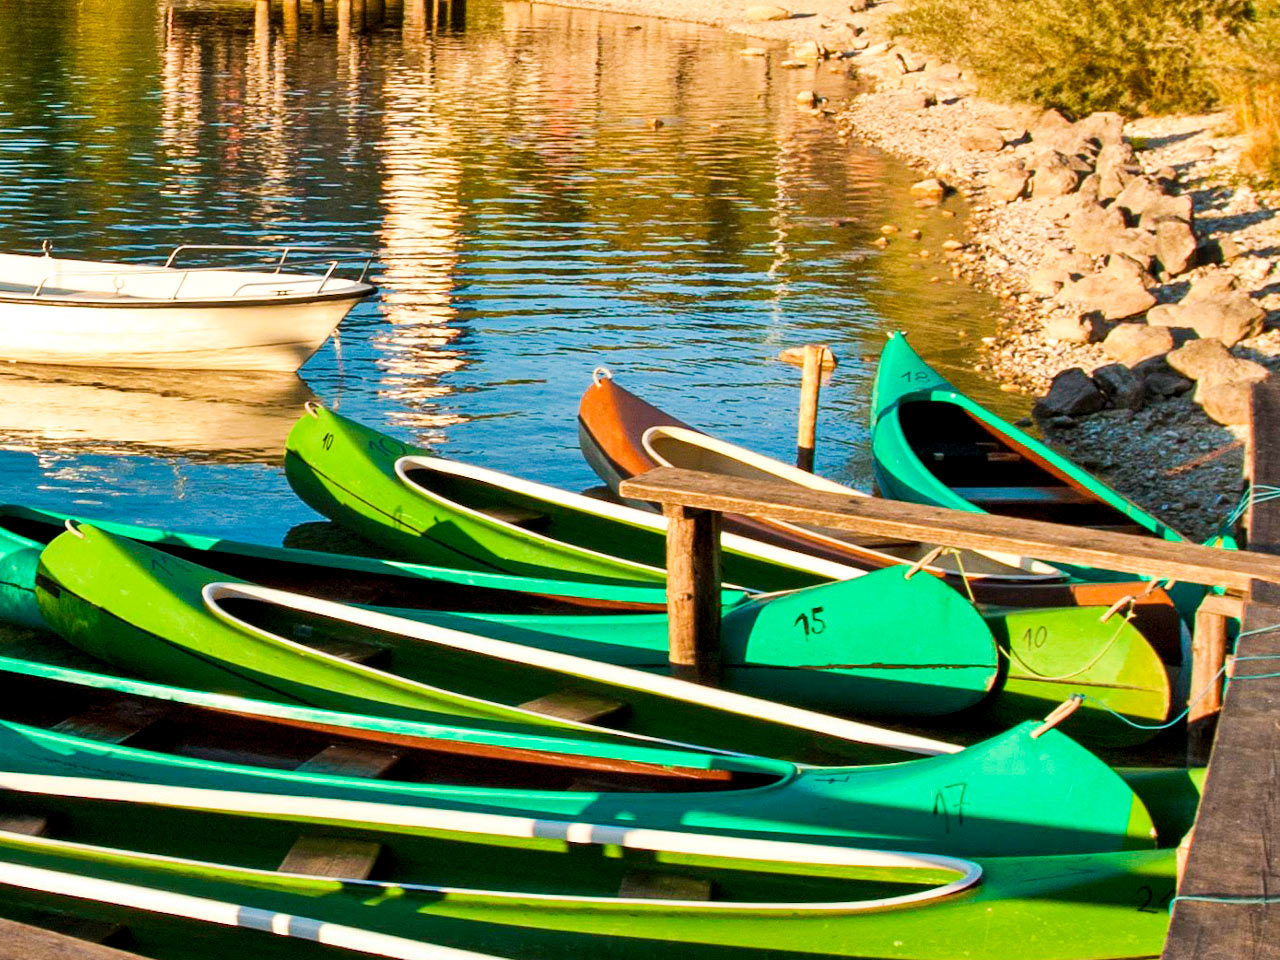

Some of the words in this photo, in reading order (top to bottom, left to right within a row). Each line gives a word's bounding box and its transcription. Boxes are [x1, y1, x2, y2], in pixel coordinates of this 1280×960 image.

[321, 431, 335, 451] 10
[793, 605, 828, 641] 15
[1022, 625, 1048, 651] 10
[931, 782, 969, 835] 17
